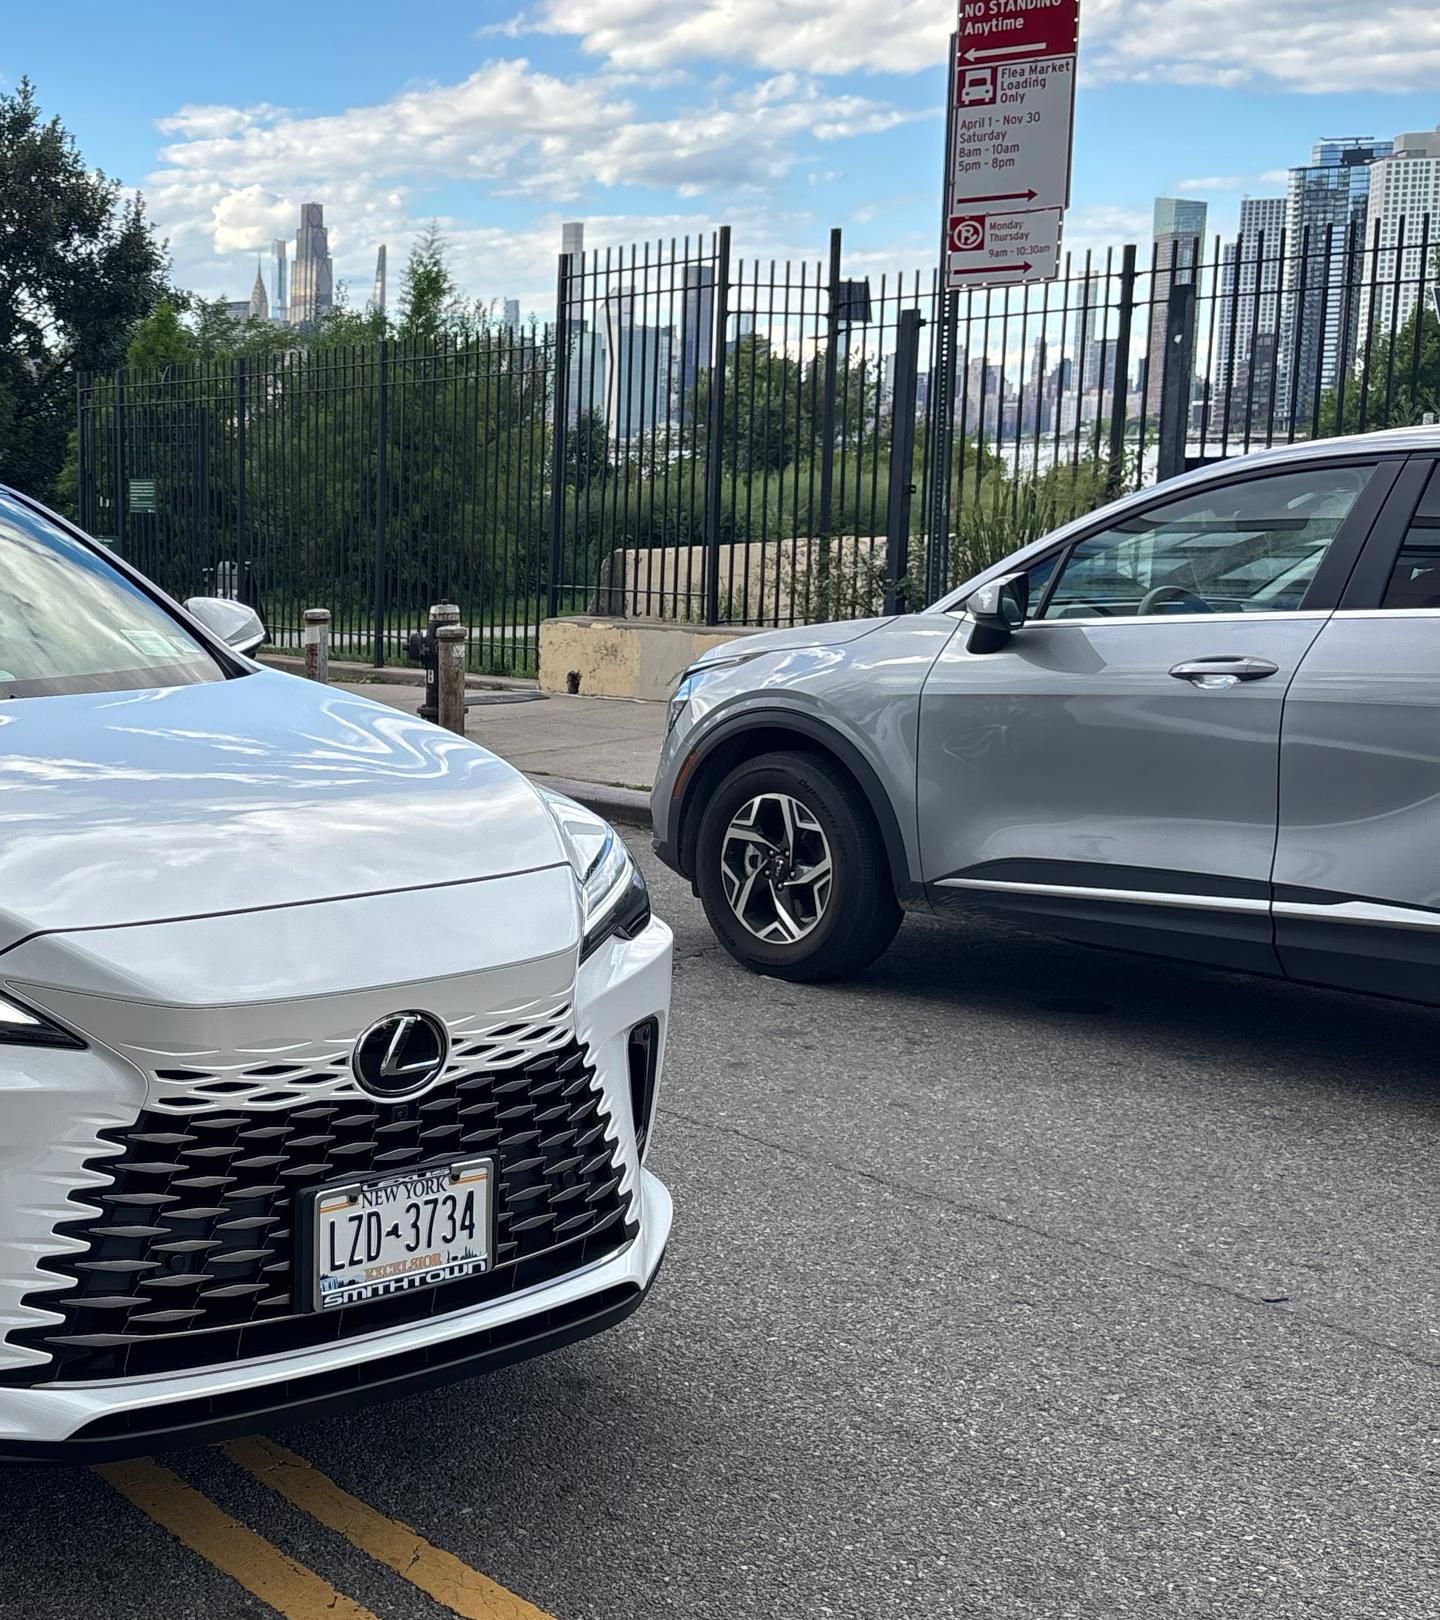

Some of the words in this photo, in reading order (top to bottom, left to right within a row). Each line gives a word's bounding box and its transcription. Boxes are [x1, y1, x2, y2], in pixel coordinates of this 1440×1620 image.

[964, 2, 985, 18] NO
[964, 17, 1025, 36] Anytime
[1001, 67, 1025, 79] Flea
[1028, 61, 1071, 76] Market
[1000, 78, 1047, 91] Loading
[1000, 91, 1026, 104] Only
[960, 117, 985, 131] April
[987, 116, 992, 127] 1
[1003, 115, 1023, 126] Nov
[1026, 111, 1041, 124] 30
[960, 130, 1008, 144] Saturday
[958, 147, 981, 158] 8am
[992, 143, 1020, 155] 10am
[958, 160, 981, 173] 5pm
[991, 157, 1015, 170] 8pm
[989, 220, 1024, 231] Monday
[989, 231, 1030, 242] Thursday
[988, 248, 1008, 258] 9am
[1016, 244, 1051, 256] 10:30am
[361, 1185, 401, 1209] NEW
[403, 1176, 448, 1200] YORK
[329, 1209, 382, 1272] LZD
[405, 1190, 476, 1252] 3734
[364, 1252, 443, 1281] EXCELSIOR
[323, 1259, 486, 1308] SMITHTOWN
